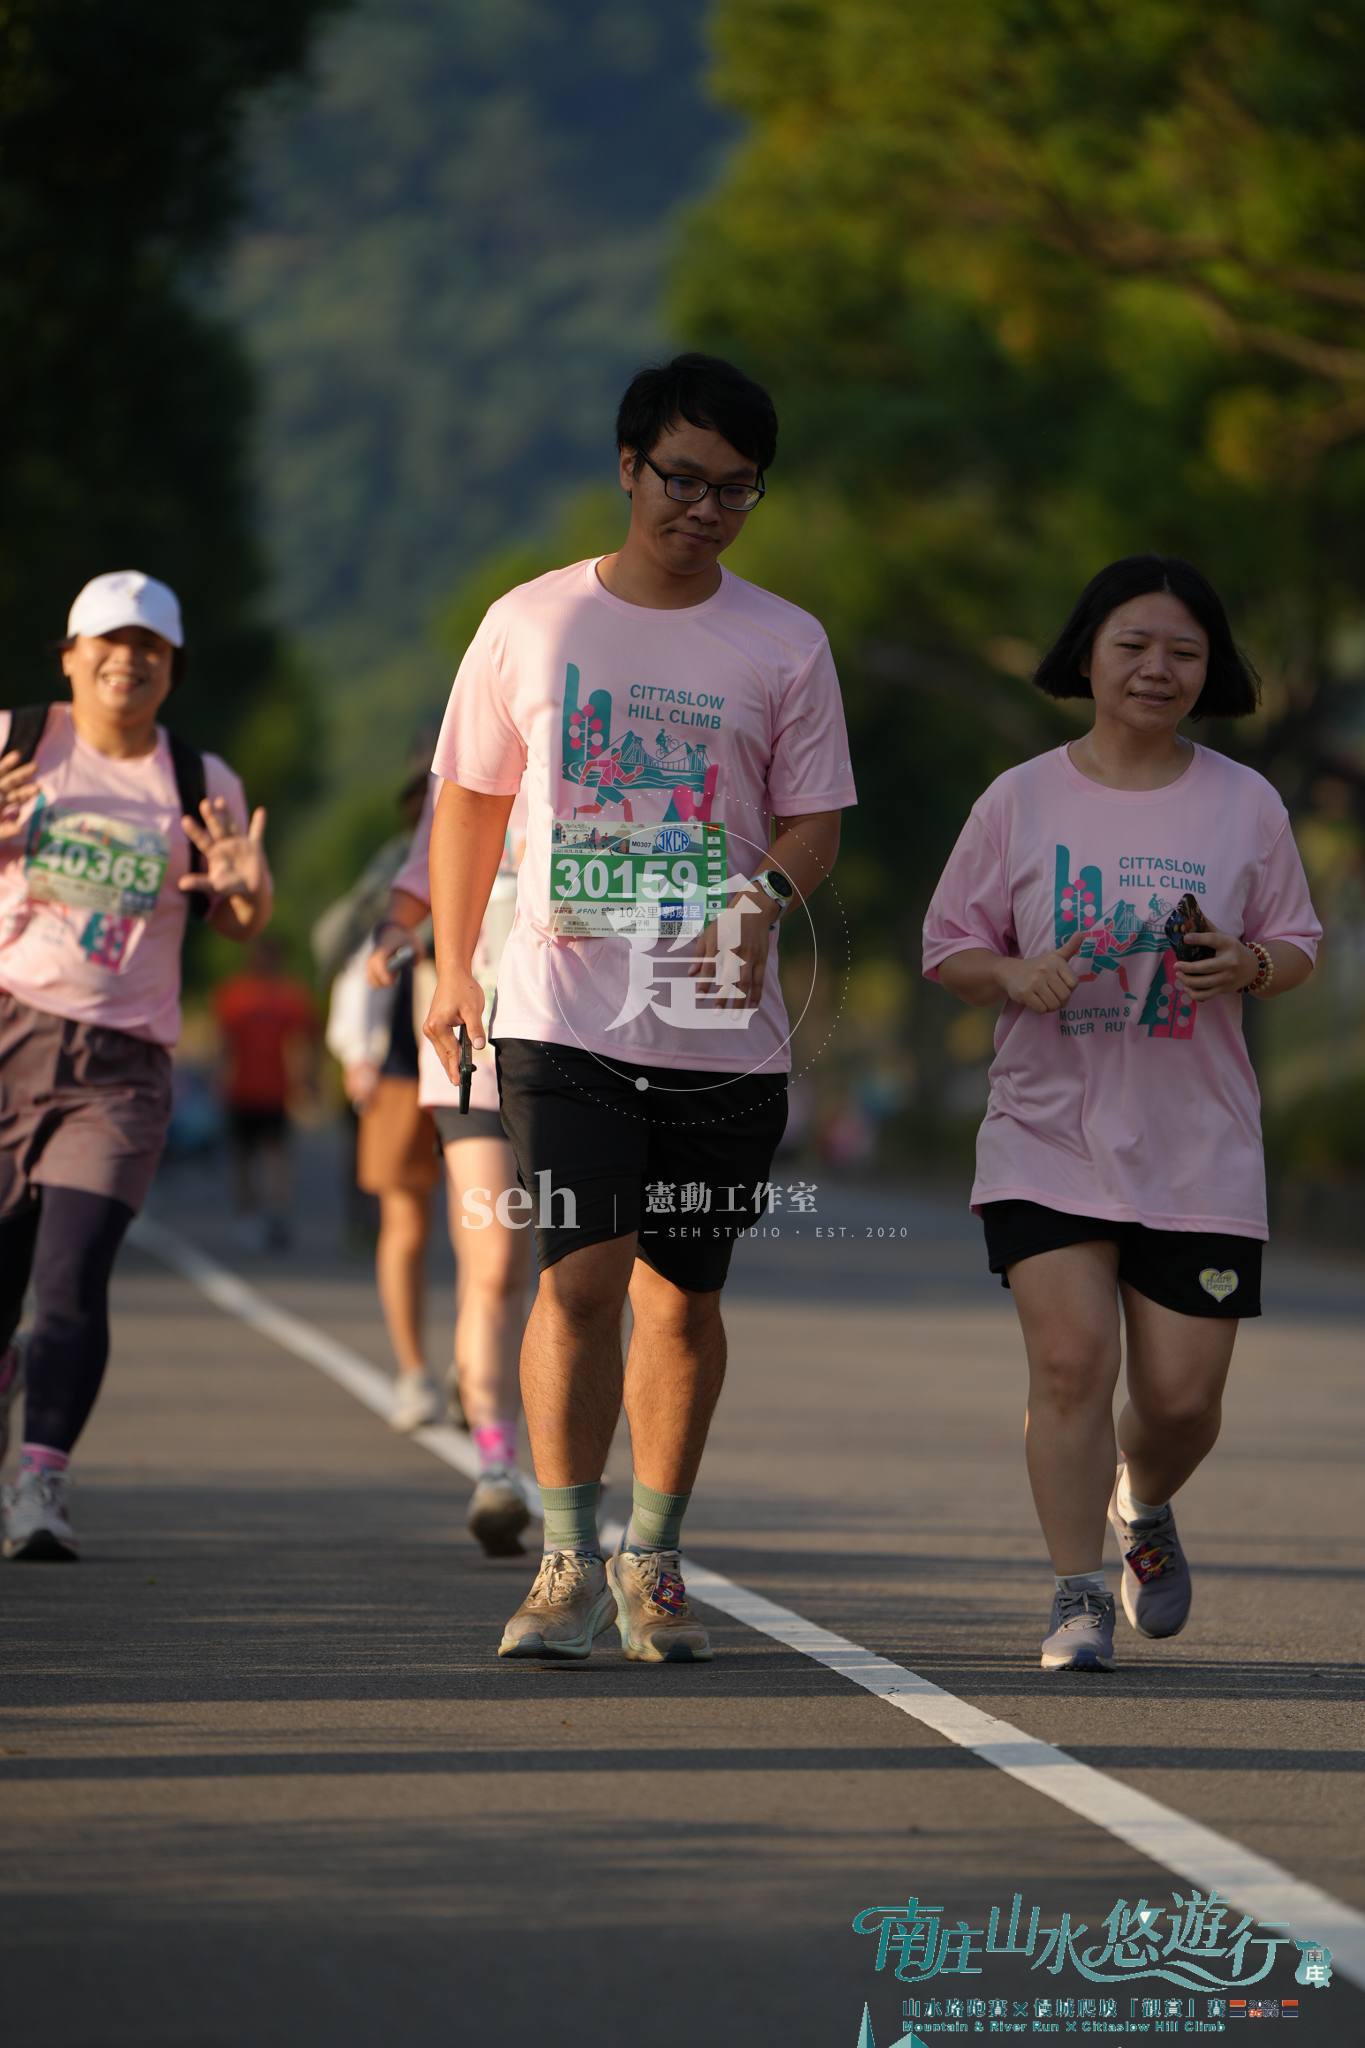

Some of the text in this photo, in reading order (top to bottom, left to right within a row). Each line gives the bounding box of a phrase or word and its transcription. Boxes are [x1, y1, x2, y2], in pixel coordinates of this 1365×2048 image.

[630, 684, 725, 710] CITTASLOW
[628, 703, 721, 730] HILL CLIMB
[656, 830, 689, 853] JKCR
[37, 838, 161, 893] 40363
[1119, 856, 1206, 877] CITTASLOW
[555, 858, 698, 900] 30159
[1119, 875, 1207, 895] HILL CLIMB
[1060, 1021, 1126, 1037] RIVER RU
